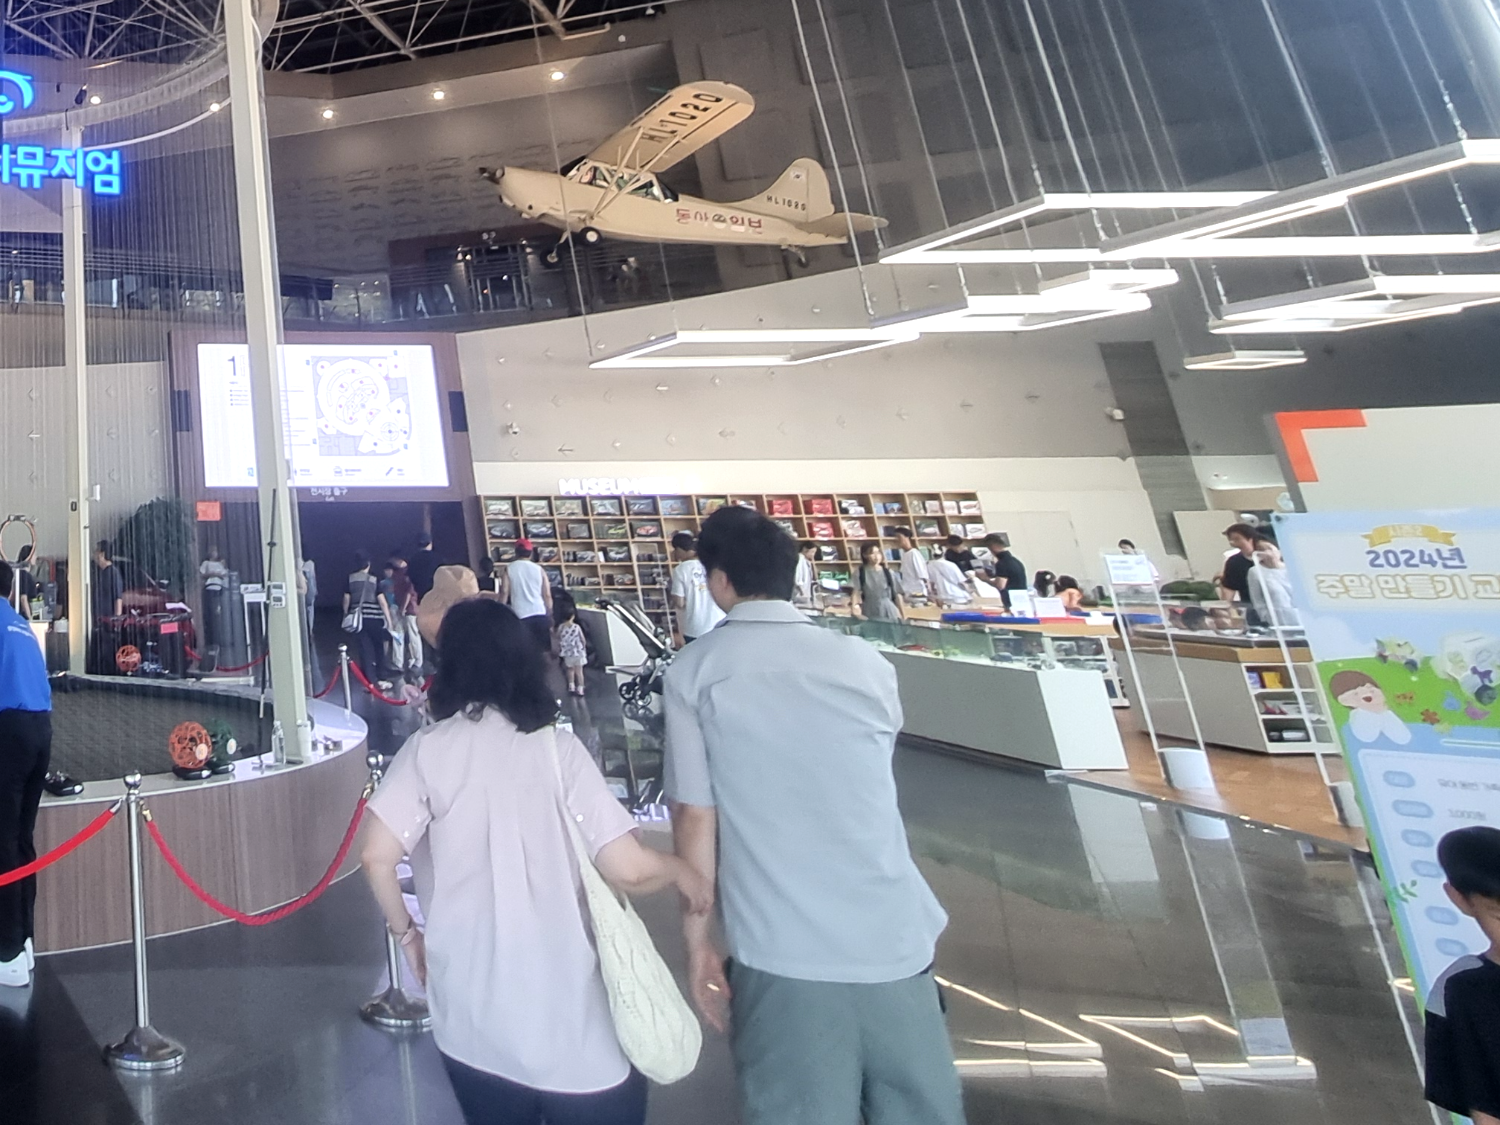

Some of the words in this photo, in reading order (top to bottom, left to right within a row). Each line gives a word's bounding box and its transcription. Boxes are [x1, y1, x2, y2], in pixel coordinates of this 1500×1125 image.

[641, 92, 724, 143] HL1020
[766, 194, 808, 212] HL1020
[1365, 546, 1468, 569] 2024년
[1315, 573, 1375, 599] 주말
[1376, 573, 1468, 600] 만들기
